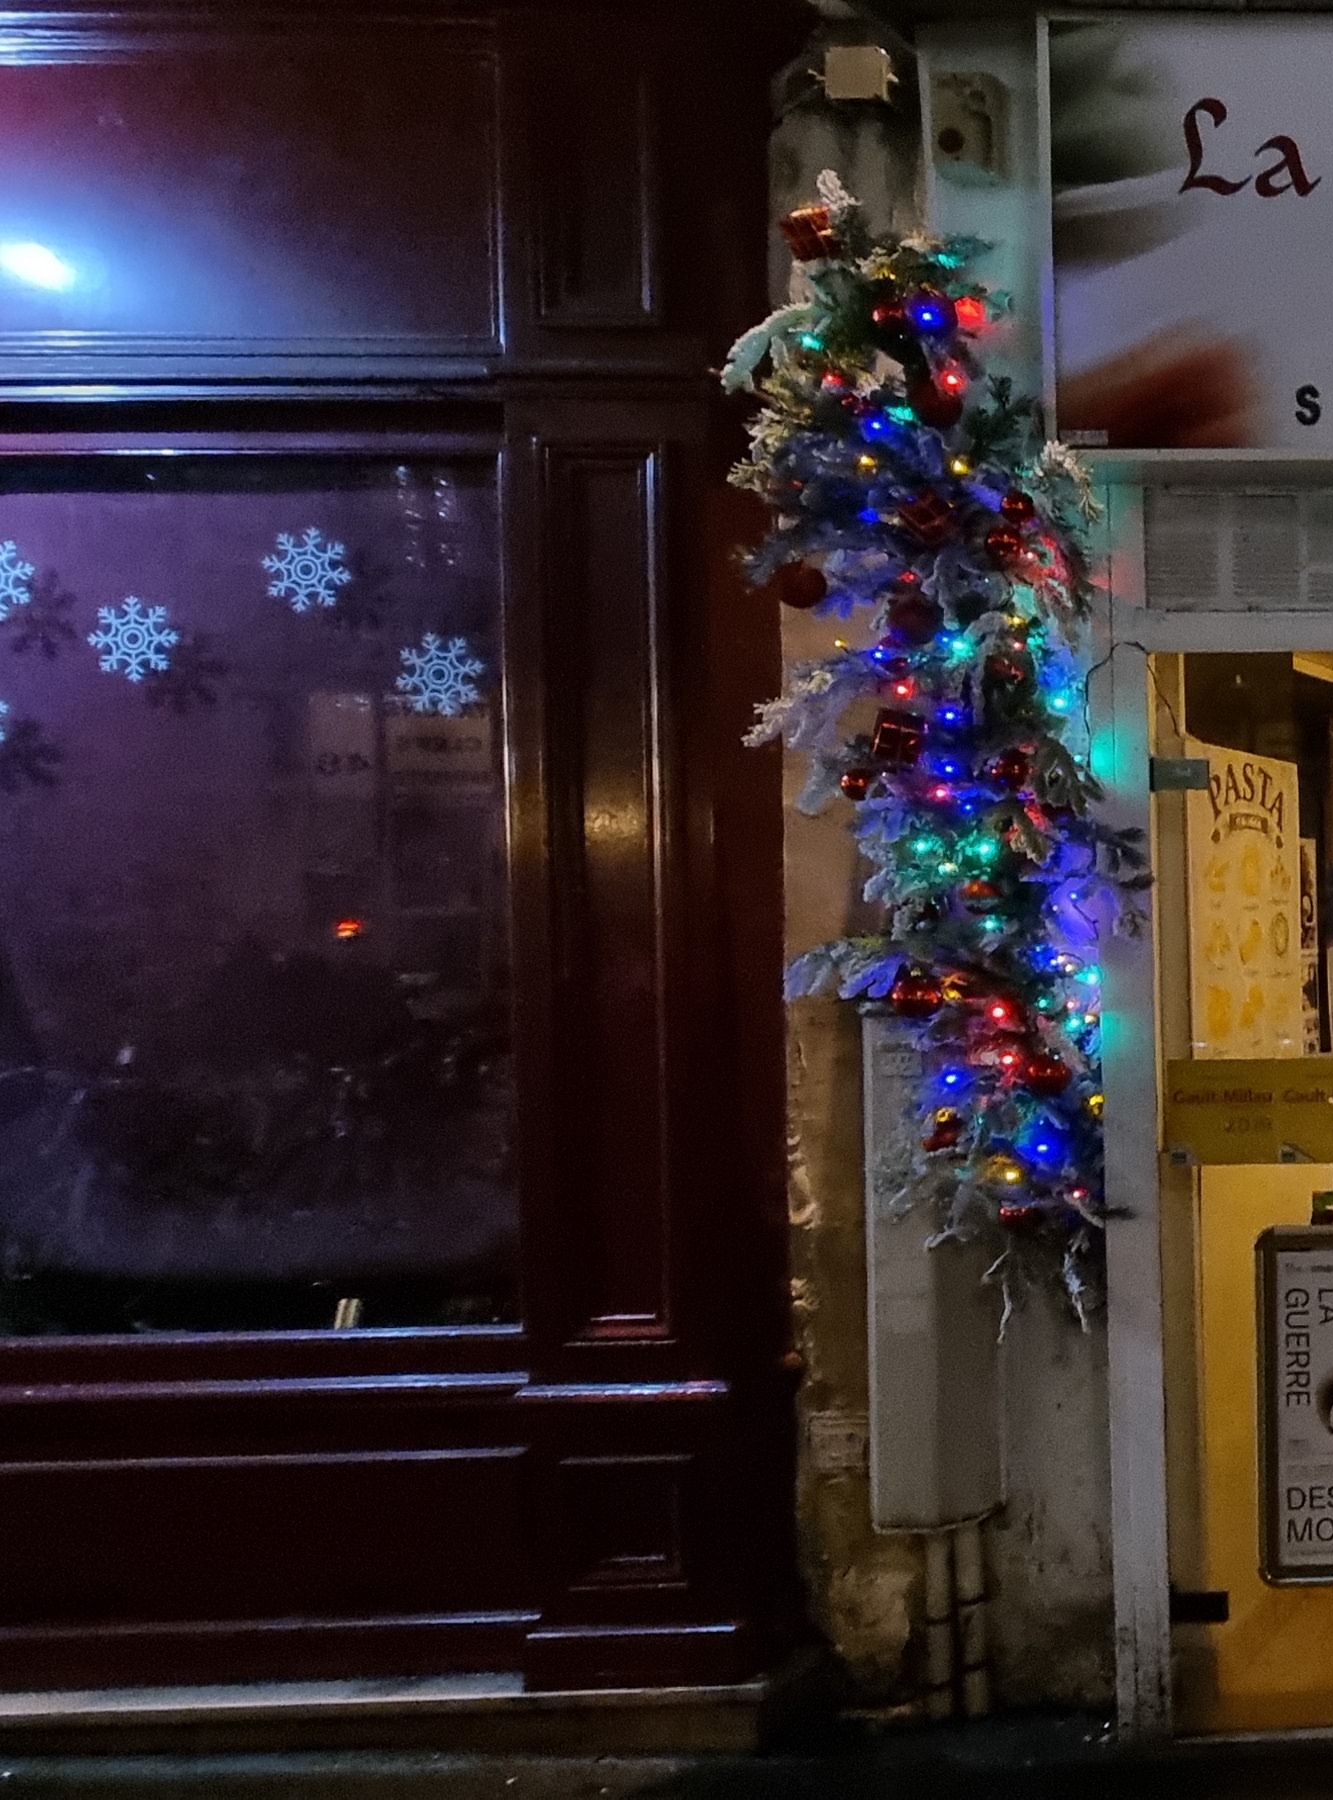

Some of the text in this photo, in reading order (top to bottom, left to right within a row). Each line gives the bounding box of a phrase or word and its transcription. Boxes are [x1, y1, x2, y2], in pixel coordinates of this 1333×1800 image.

[1180, 97, 1322, 198] La
[1208, 762, 1284, 834] PASTA
[1284, 1287, 1311, 1407] GUERRE
